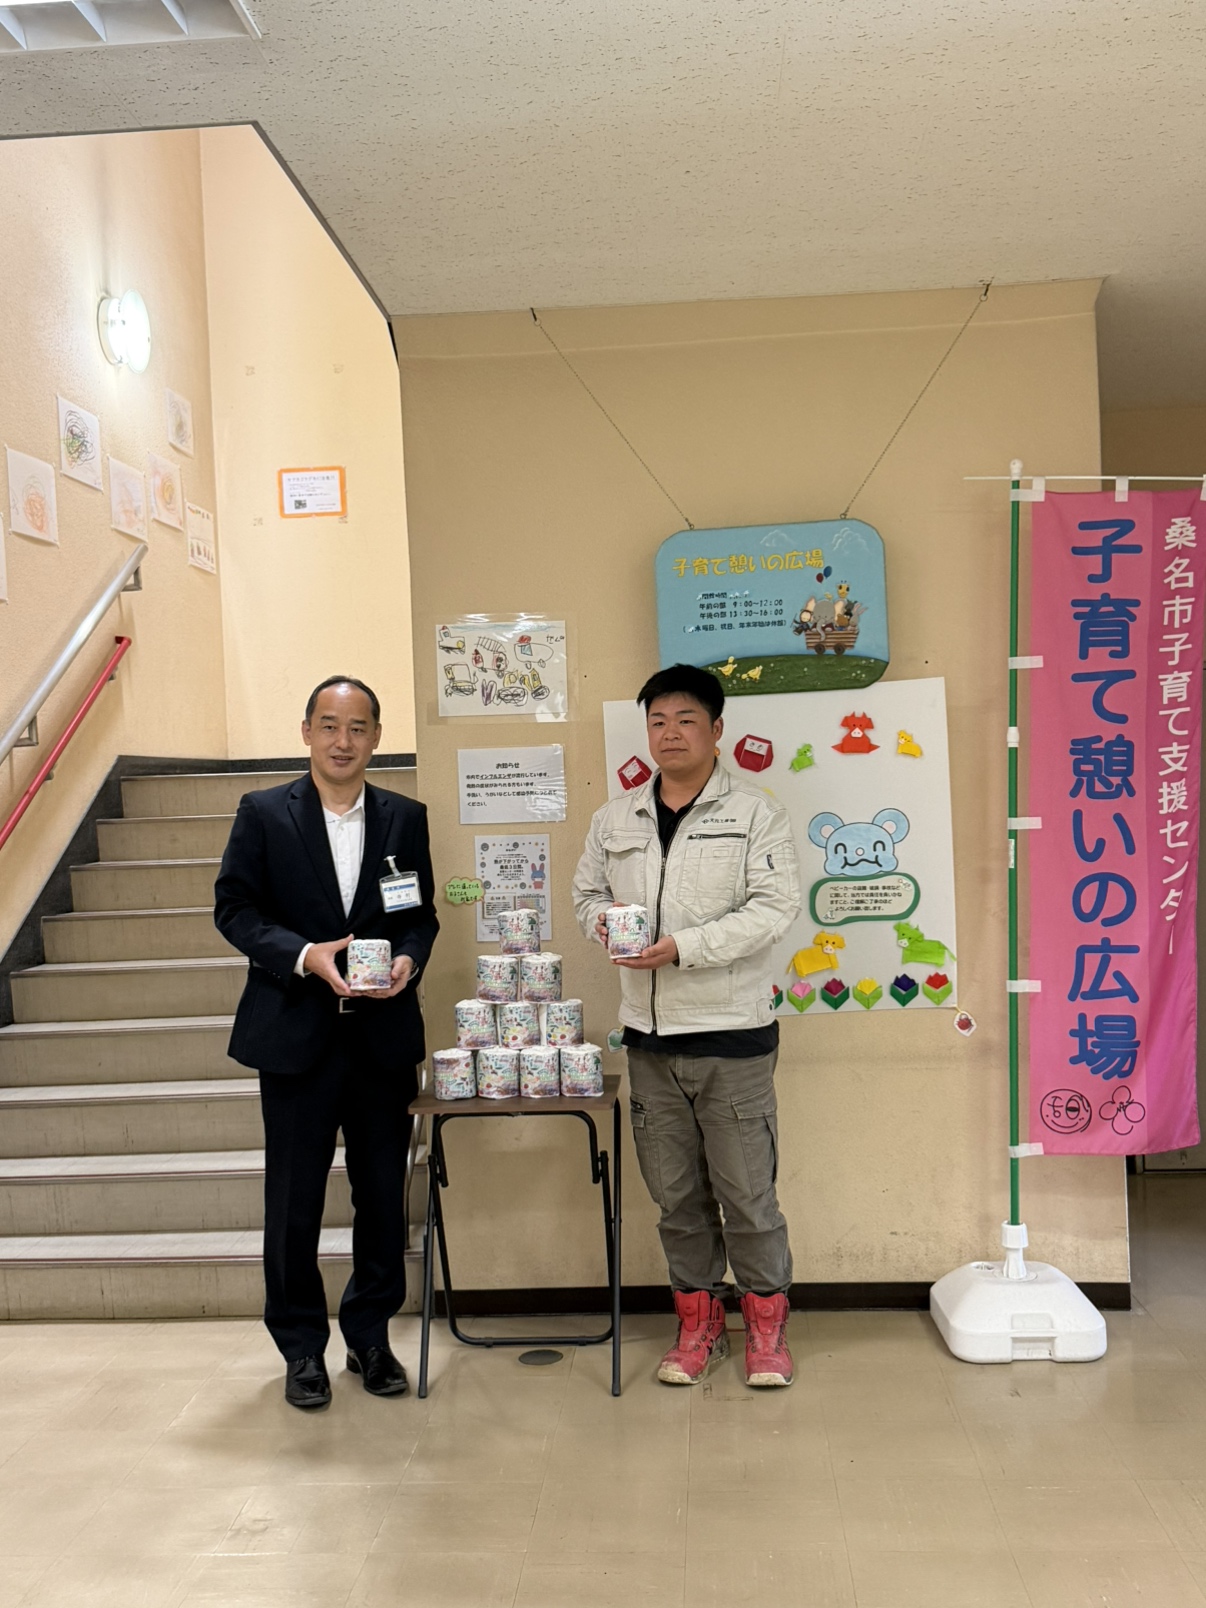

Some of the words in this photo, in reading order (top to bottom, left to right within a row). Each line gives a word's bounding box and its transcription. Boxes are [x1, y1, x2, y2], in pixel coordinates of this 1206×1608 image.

[672, 549, 825, 578] 子育て憩いの広場
[699, 602, 727, 610] 午前の部
[699, 611, 727, 619] 午後の部
[1158, 516, 1197, 955] 桑名市子育て支援センター
[1067, 519, 1143, 1081] 子育て憩いの広場
